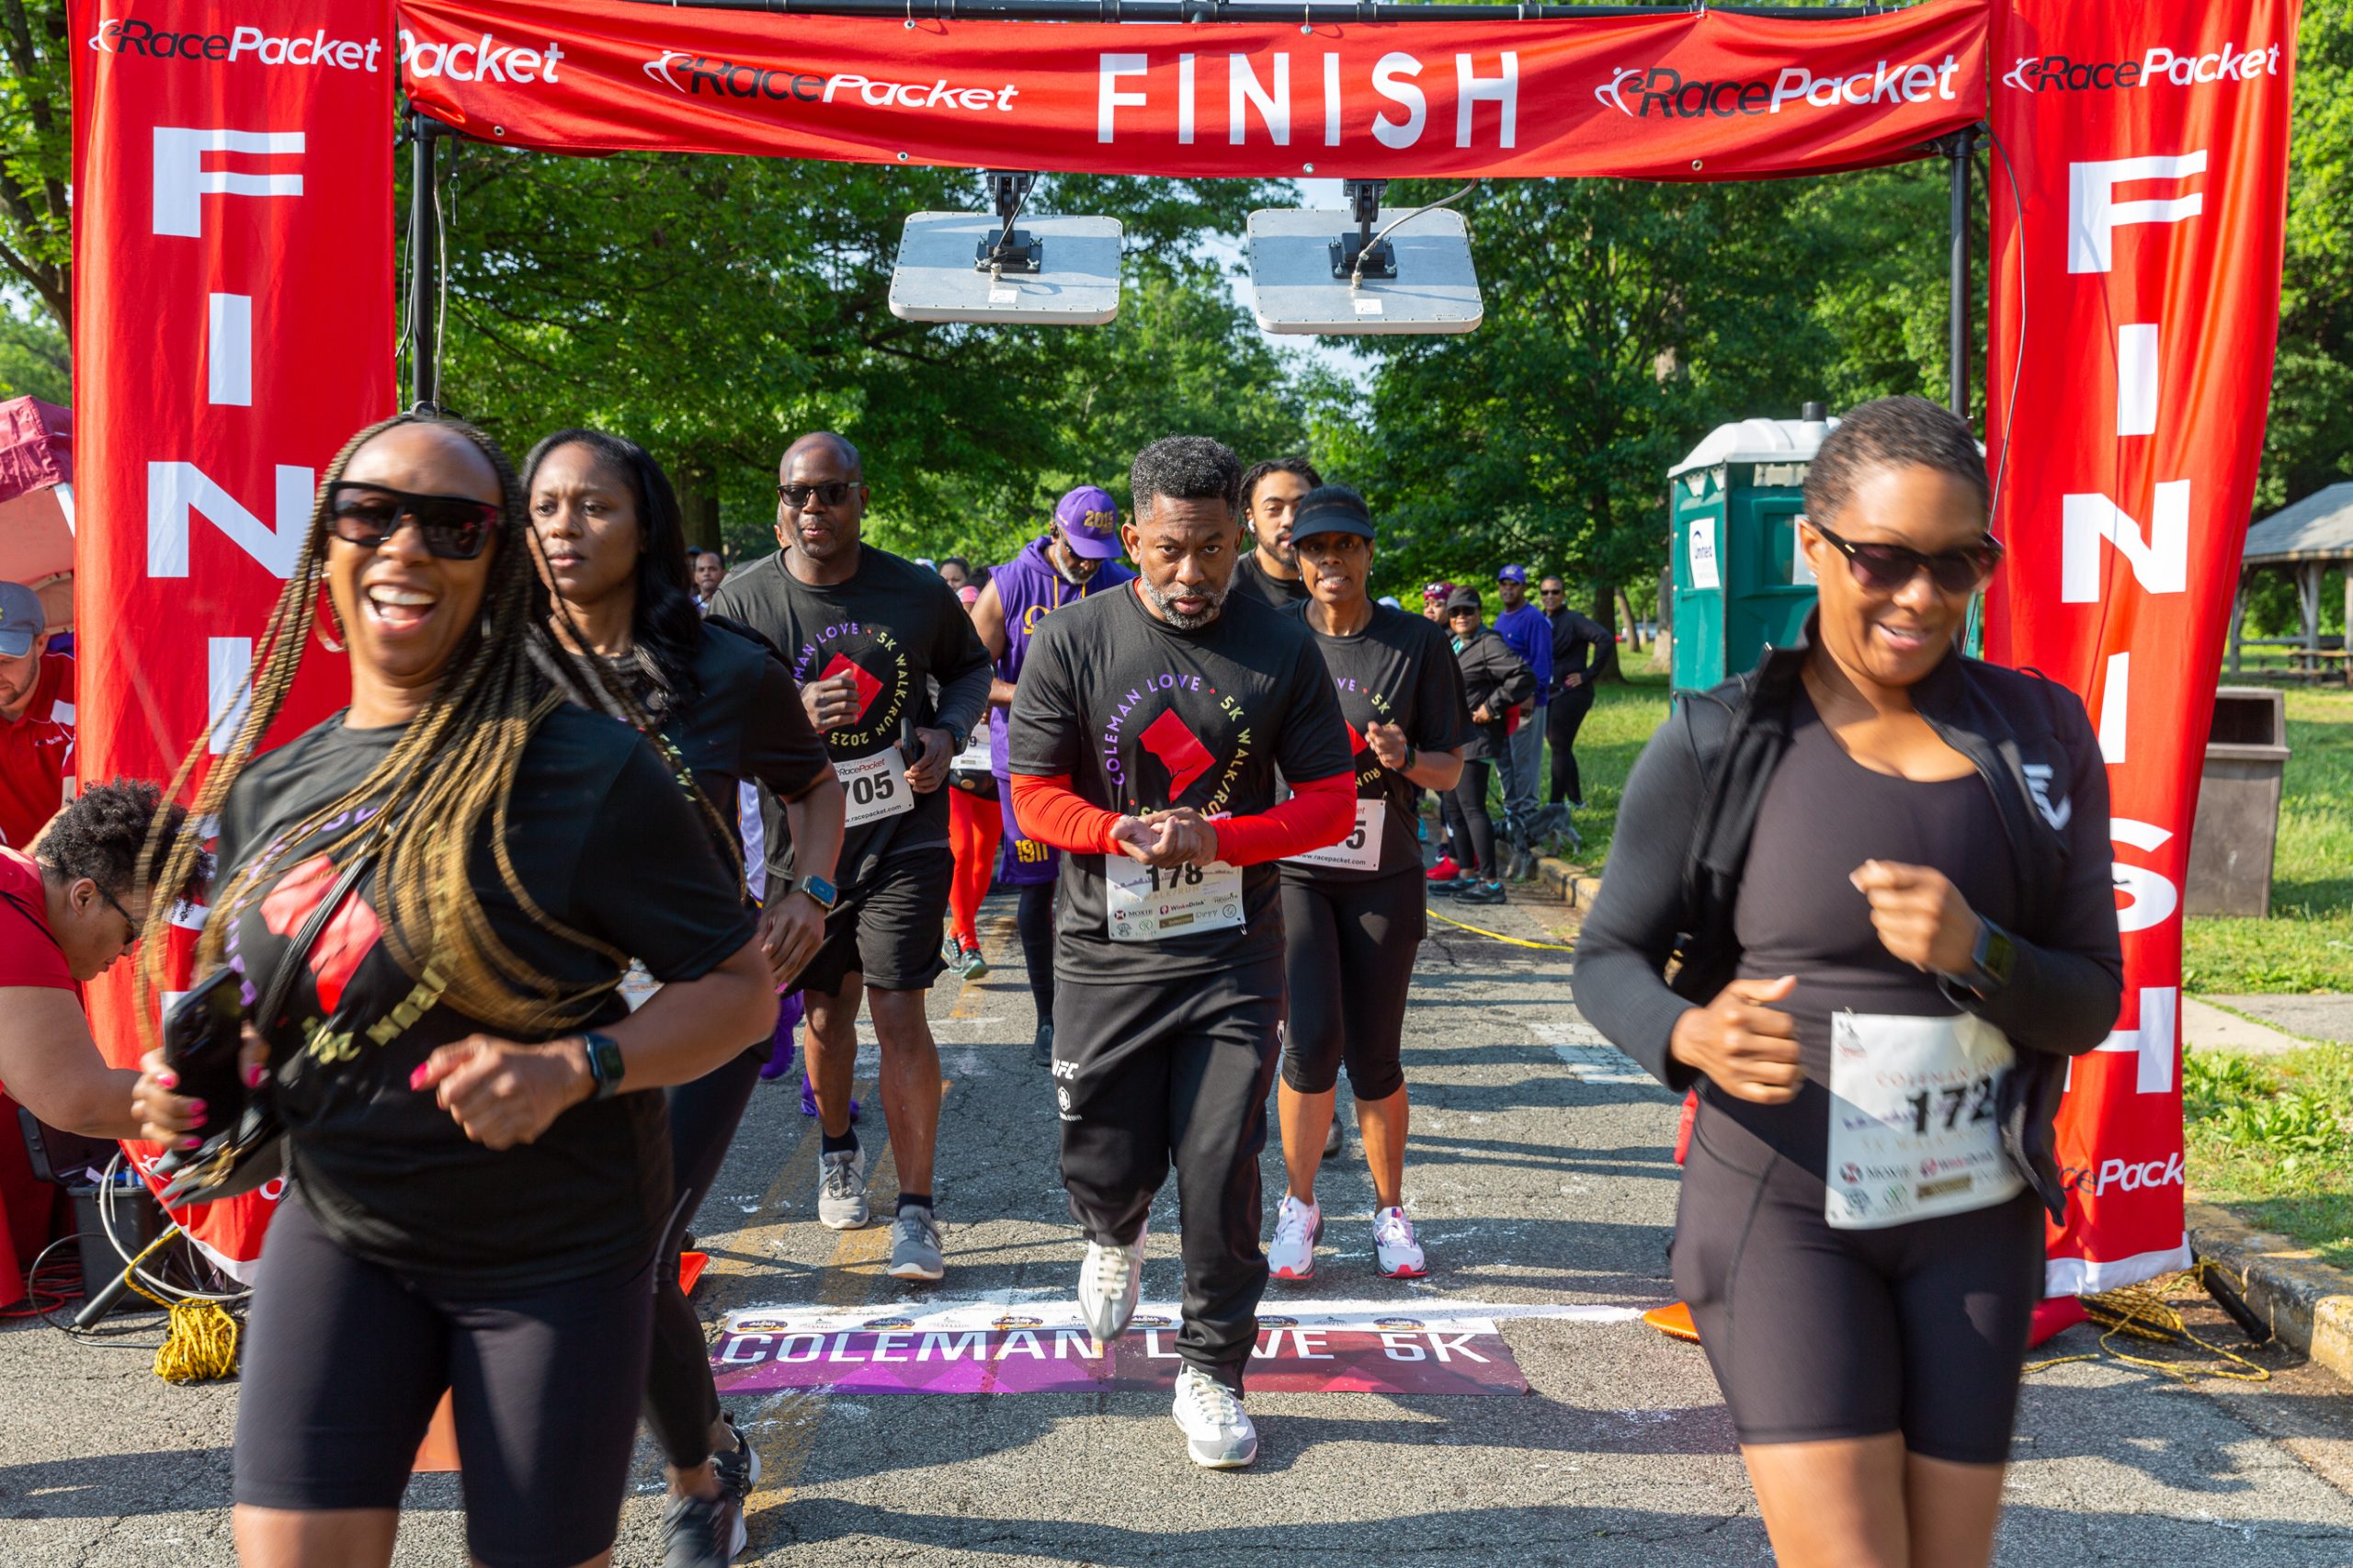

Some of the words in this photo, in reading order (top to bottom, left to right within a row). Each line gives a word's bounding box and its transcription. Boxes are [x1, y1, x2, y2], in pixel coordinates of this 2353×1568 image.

[116, 18, 381, 73] RacePacket
[2037, 41, 2280, 93] RacePacket
[689, 57, 1019, 112] RacePacket
[1097, 51, 1518, 149] FINISH
[1638, 54, 1959, 118] RacePacket
[815, 622, 858, 644] LOVE
[876, 631, 897, 652] 5K
[874, 653, 913, 735] WALK/RUN
[1371, 693, 1391, 714] 5K
[829, 732, 870, 746] 2023
[1104, 688, 1142, 786] COLEMAN
[1146, 674, 1200, 693] LOVE
[1220, 695, 1244, 722] 5K
[846, 804, 902, 824] w.racepacket.com
[1015, 839, 1049, 863] 1911
[1145, 861, 1203, 892] 178
[1051, 1058, 1079, 1080] UFC
[721, 1330, 1103, 1363] COLEMAN
[1145, 1329, 1335, 1360] LVE
[1380, 1333, 1492, 1363] 5K
